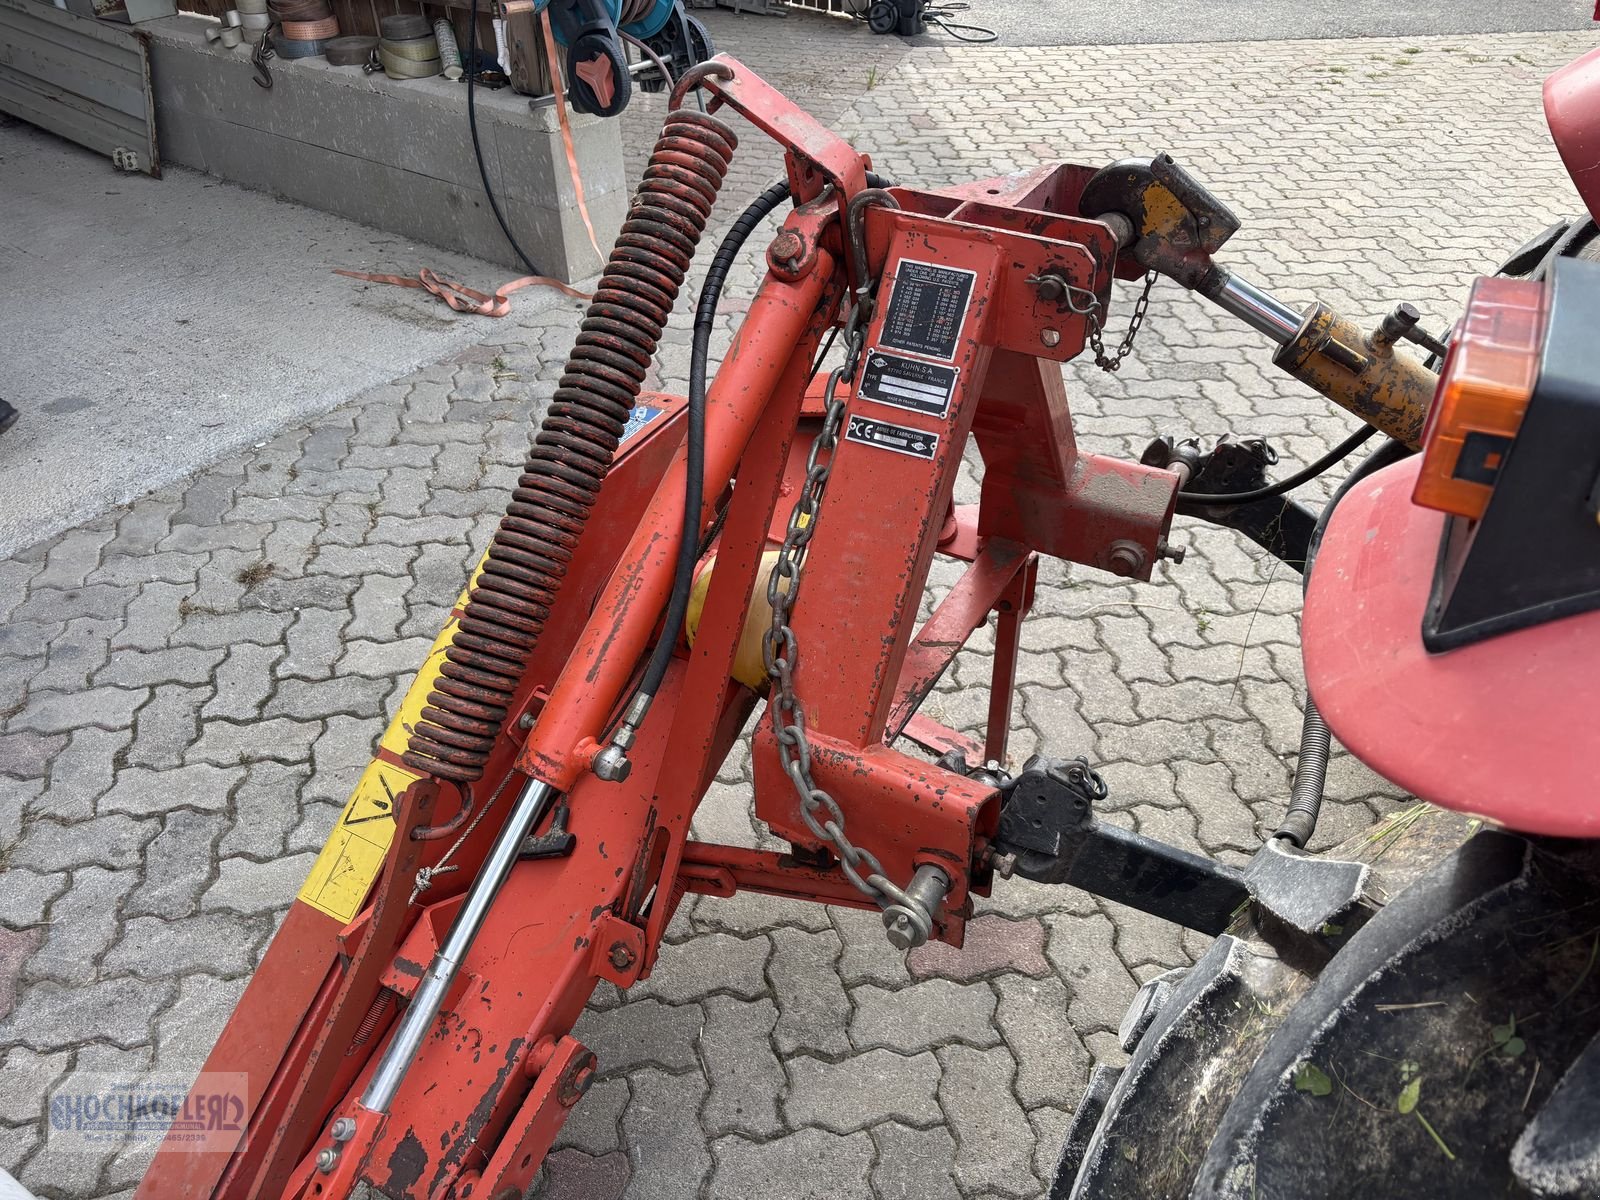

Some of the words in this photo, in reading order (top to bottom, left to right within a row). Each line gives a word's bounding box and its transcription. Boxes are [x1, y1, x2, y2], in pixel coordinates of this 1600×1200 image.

[937, 269, 968, 279] MANUFACTURED
[923, 344, 941, 352] PENDING
[902, 370, 924, 379] SAVERNE
[927, 376, 946, 384] FRANCE
[896, 430, 923, 441] FABRICATION
